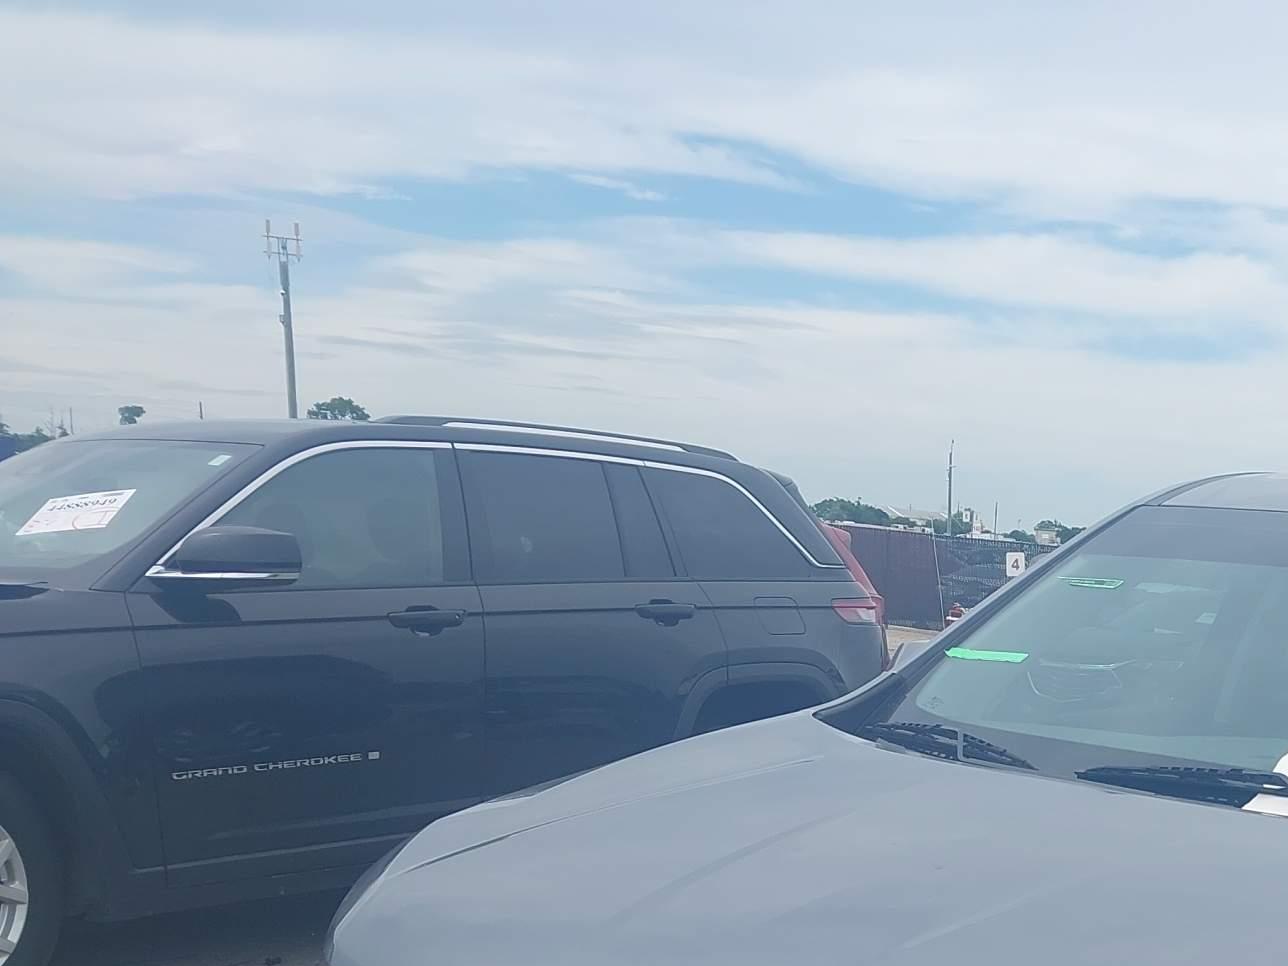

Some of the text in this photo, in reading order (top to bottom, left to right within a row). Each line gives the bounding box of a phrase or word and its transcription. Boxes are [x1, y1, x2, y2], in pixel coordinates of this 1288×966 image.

[1011, 558, 1021, 571] 4
[171, 765, 248, 780] GRAND
[253, 753, 363, 771] CHEROKEE
